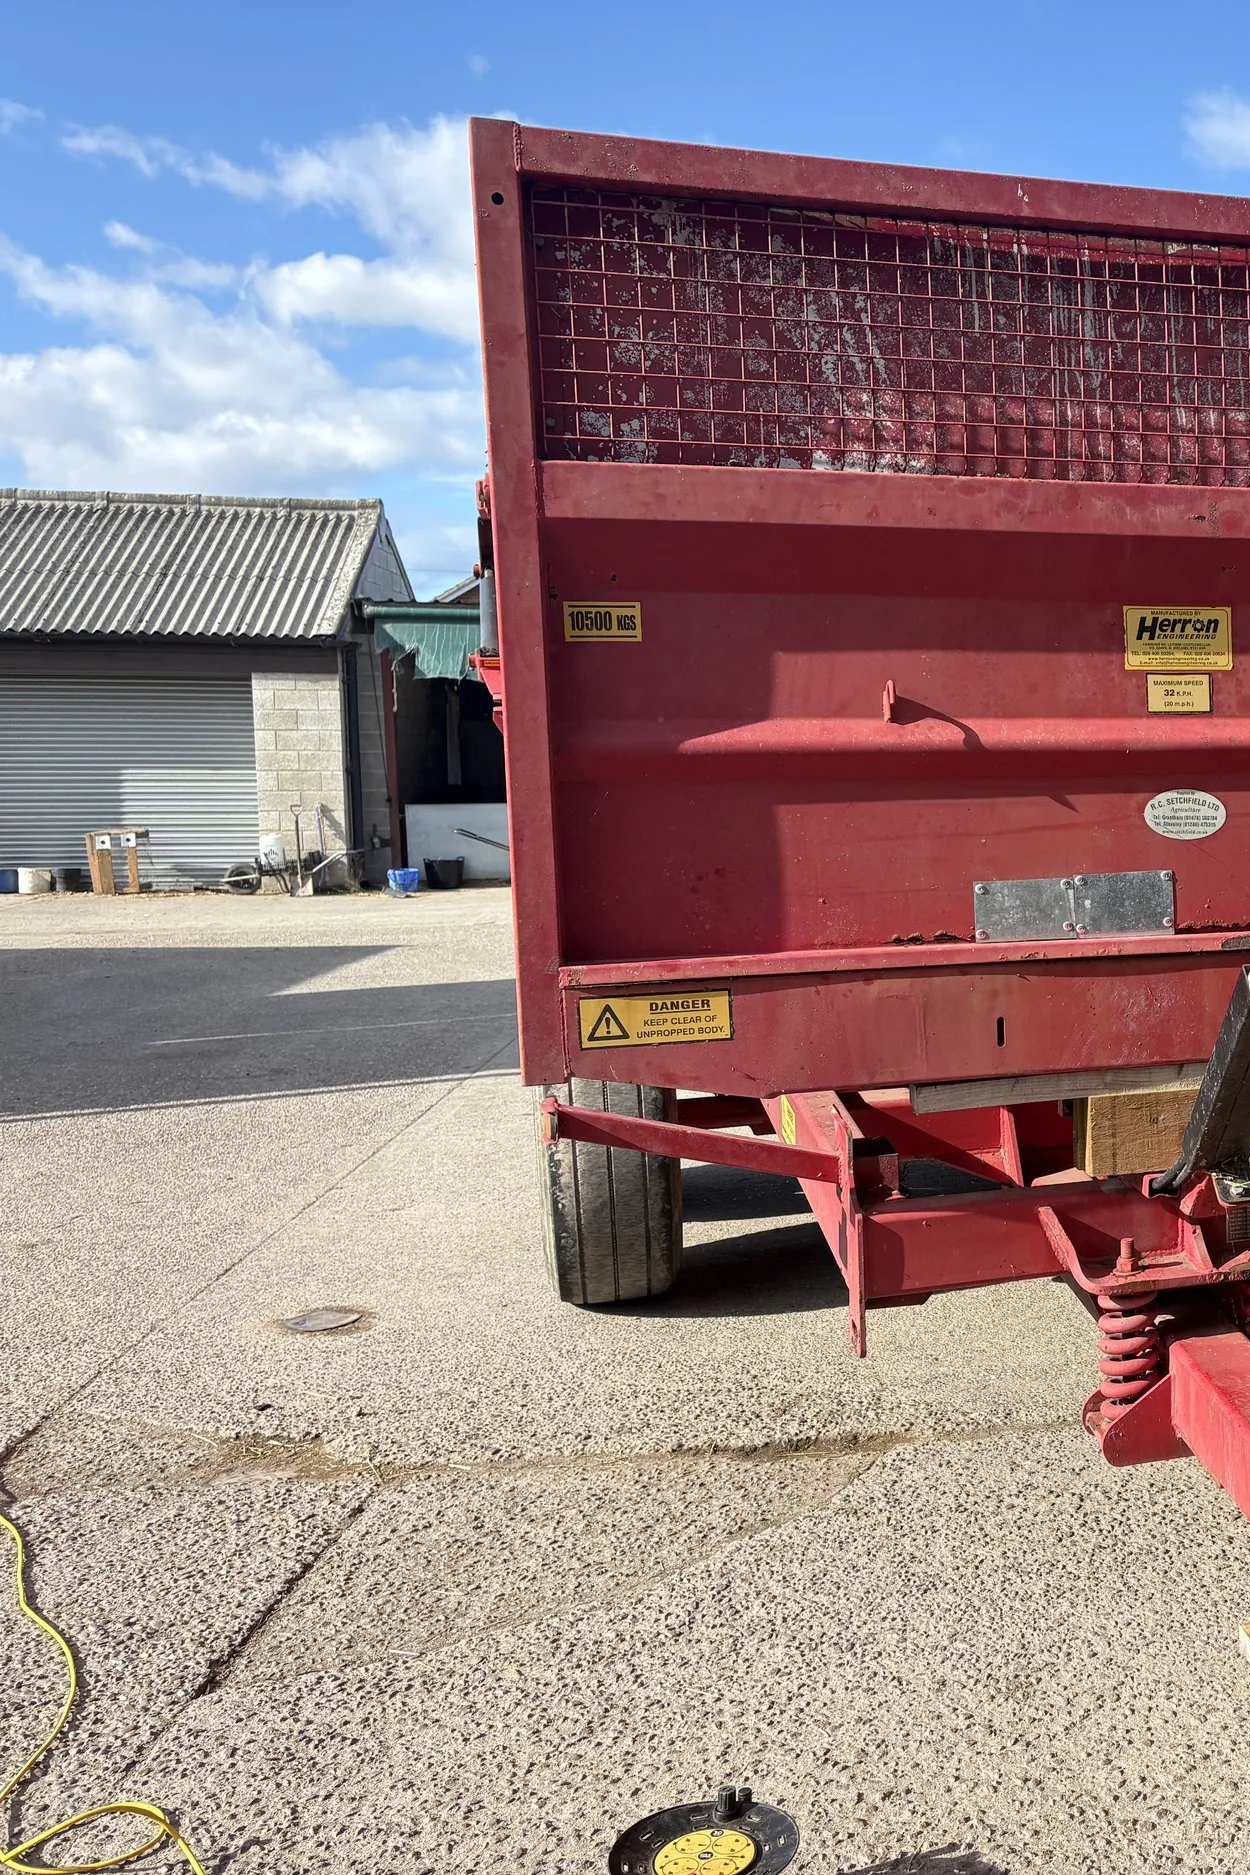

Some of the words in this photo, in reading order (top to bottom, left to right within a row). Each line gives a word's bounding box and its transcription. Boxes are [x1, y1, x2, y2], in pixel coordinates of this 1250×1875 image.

[568, 610, 612, 632] 10500
[616, 614, 637, 631] KGS
[1136, 616, 1219, 640] Herron
[1163, 689, 1175, 697] 32
[1166, 797, 1207, 807] SETCHFIELD
[1207, 801, 1220, 812] LTD
[649, 998, 711, 1012] DANGER
[643, 1017, 668, 1027] KEEP
[671, 1015, 702, 1025] CLEAR
[704, 1014, 718, 1023] OF
[636, 1028, 695, 1039] UNPROPPED
[698, 1026, 726, 1036] BODY.
